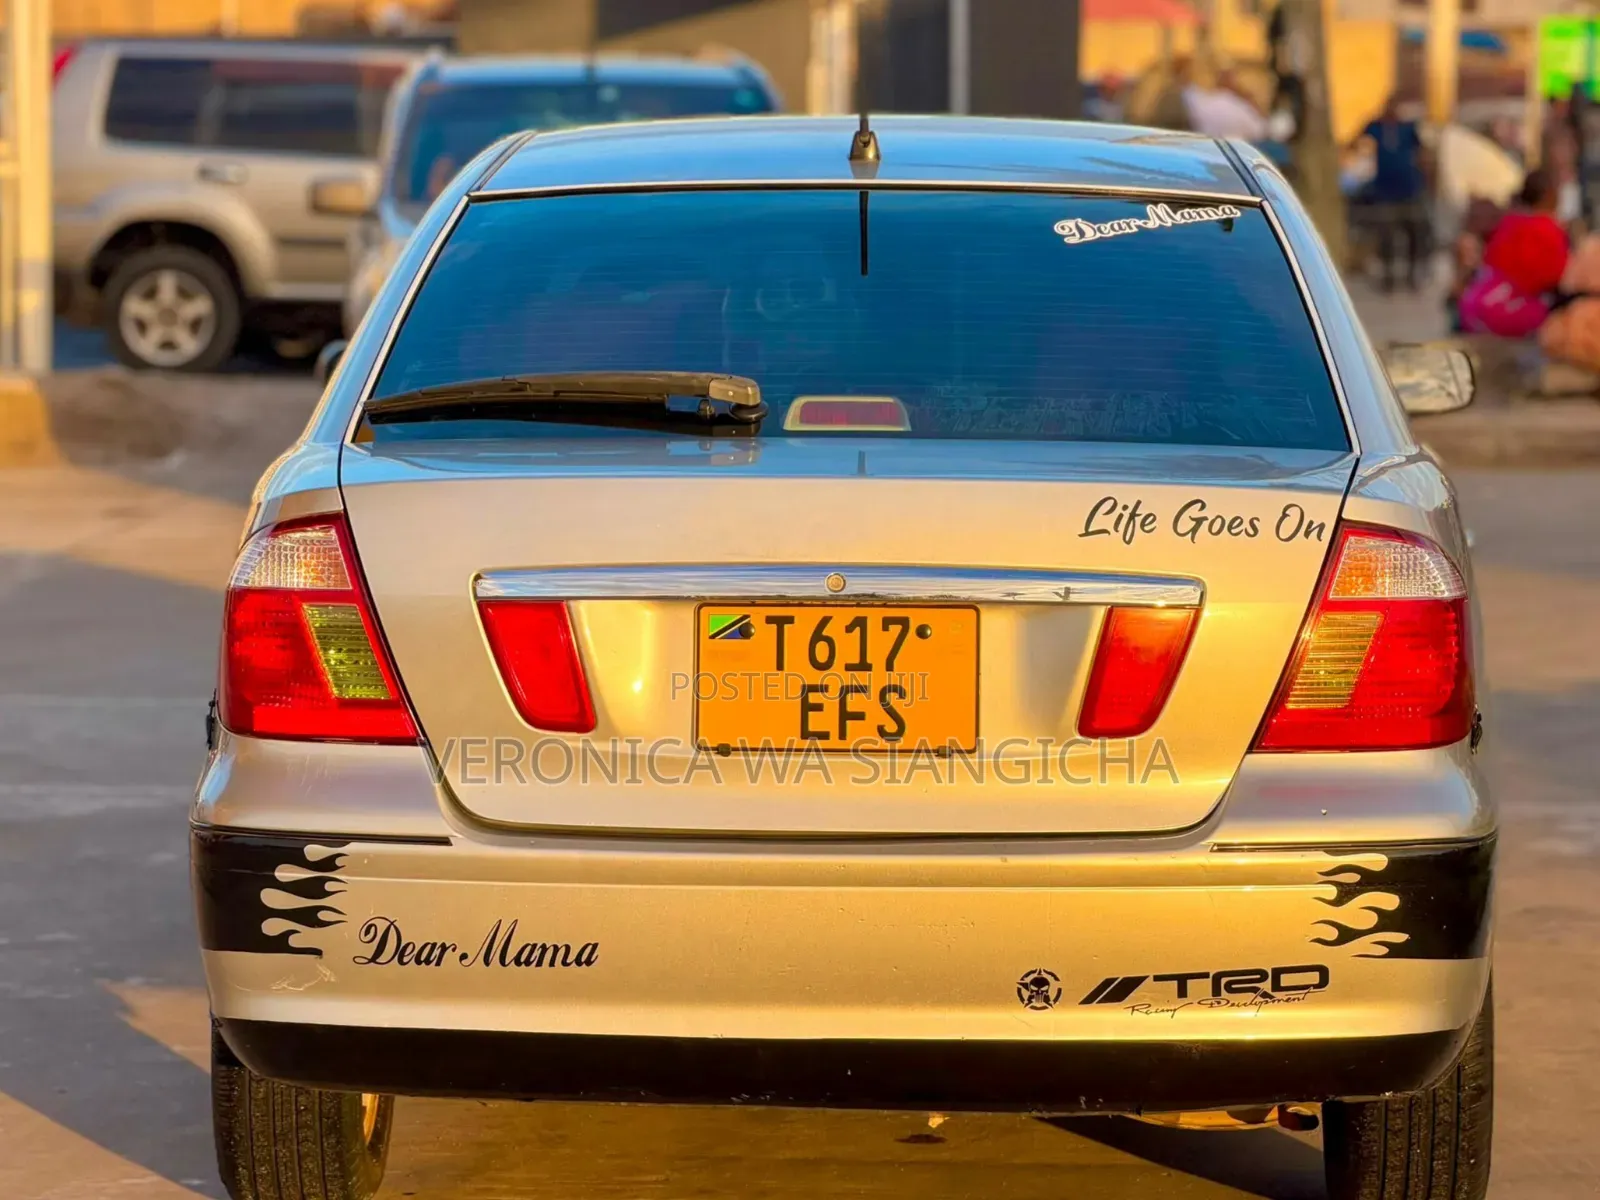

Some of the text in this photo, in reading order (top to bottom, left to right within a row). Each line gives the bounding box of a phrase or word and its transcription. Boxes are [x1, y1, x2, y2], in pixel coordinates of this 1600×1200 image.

[1054, 203, 1241, 243] Dear Mama
[1077, 496, 1327, 546] Life Goes On
[799, 683, 908, 742] EFS
[352, 916, 600, 968] Dear Mama
[1152, 964, 1330, 1000] TRD
